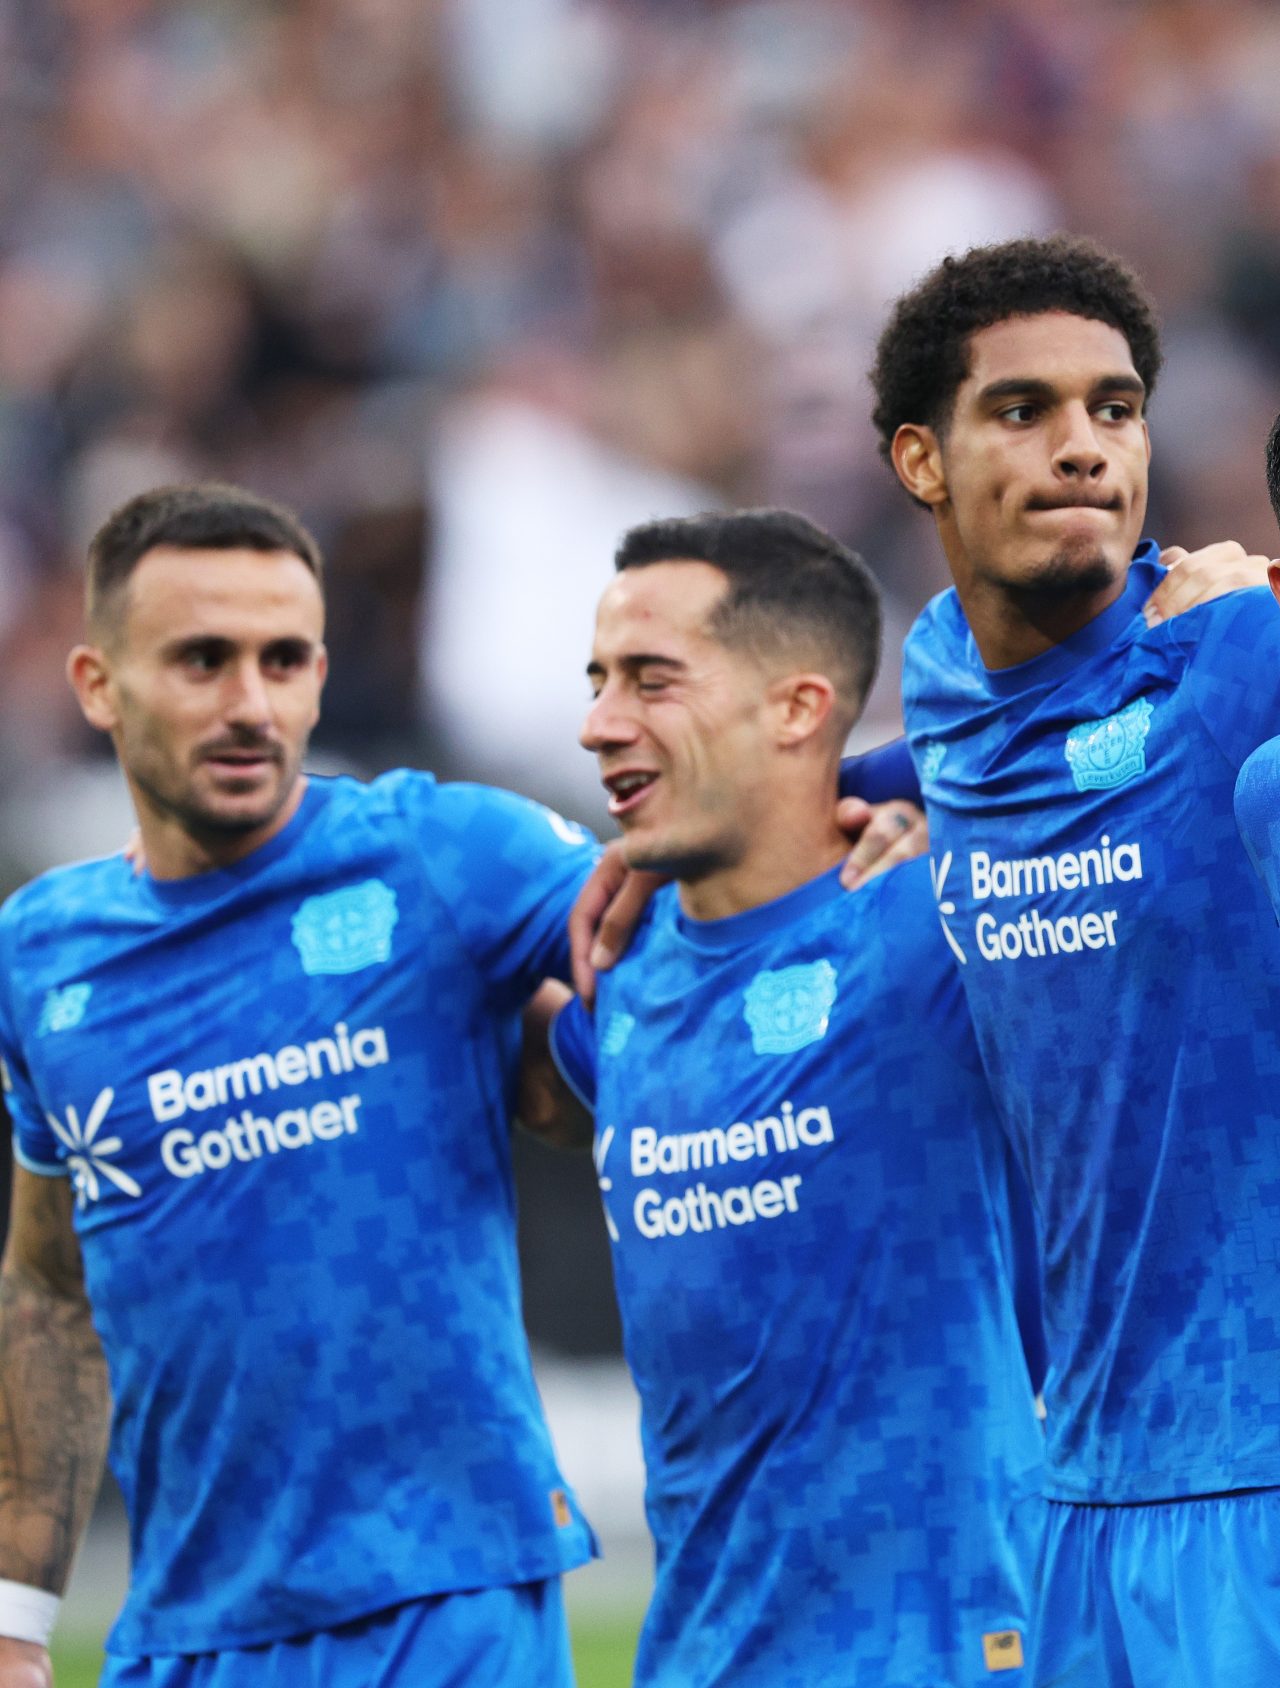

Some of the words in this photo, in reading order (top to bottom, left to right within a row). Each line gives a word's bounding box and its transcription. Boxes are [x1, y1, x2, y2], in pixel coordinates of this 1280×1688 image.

[970, 834, 1143, 900] Barmenia
[975, 908, 1119, 962] Gothaer
[147, 1021, 390, 1123] Barmenia
[160, 1093, 362, 1179] Gothaer
[630, 1100, 835, 1178] Barmenia
[633, 1173, 803, 1240] Gothaer
